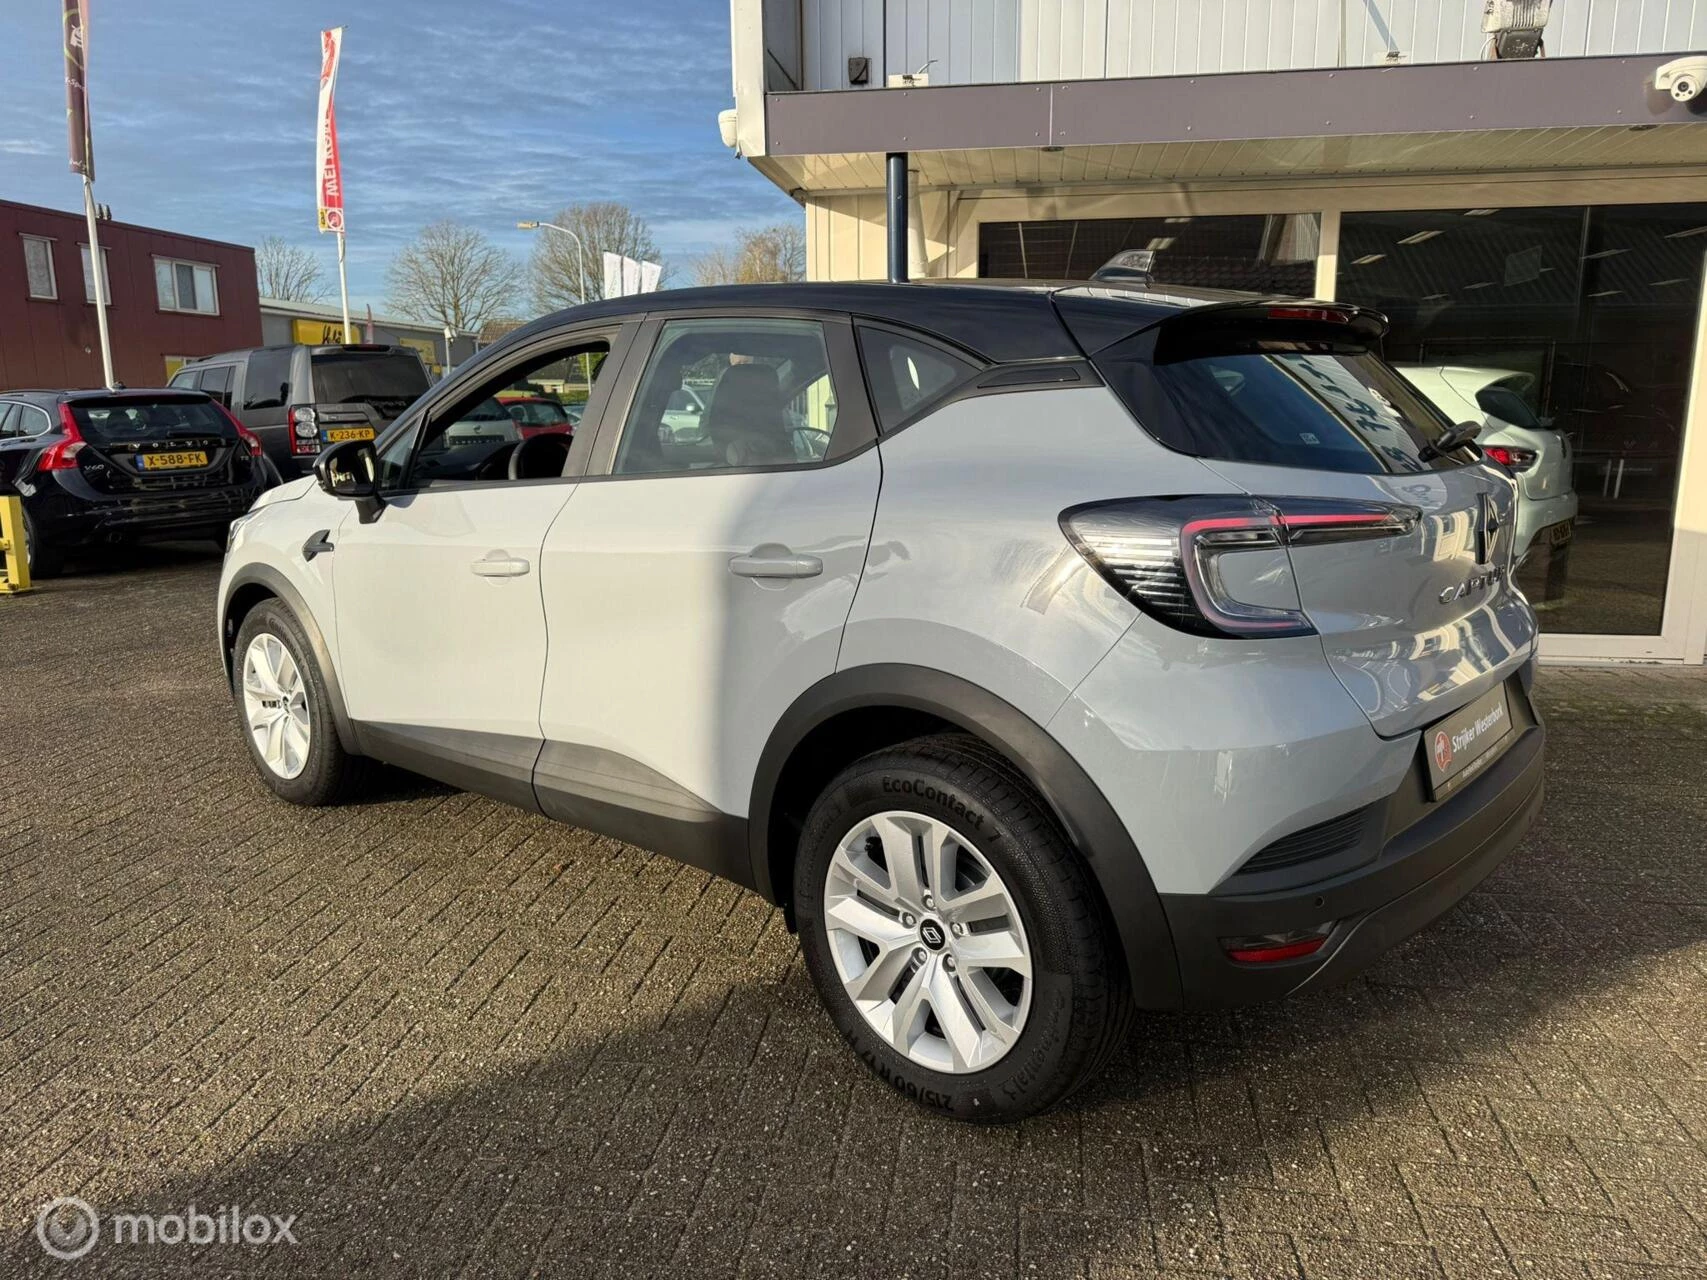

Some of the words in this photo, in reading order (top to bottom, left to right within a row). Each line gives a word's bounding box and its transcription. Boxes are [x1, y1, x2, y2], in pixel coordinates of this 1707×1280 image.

[329, 429, 371, 440] K-236-KP
[133, 439, 209, 449] VOLVO
[149, 452, 204, 467] X-588-FK
[1452, 727, 1475, 753] Strijker
[882, 776, 985, 831] EcoContact
